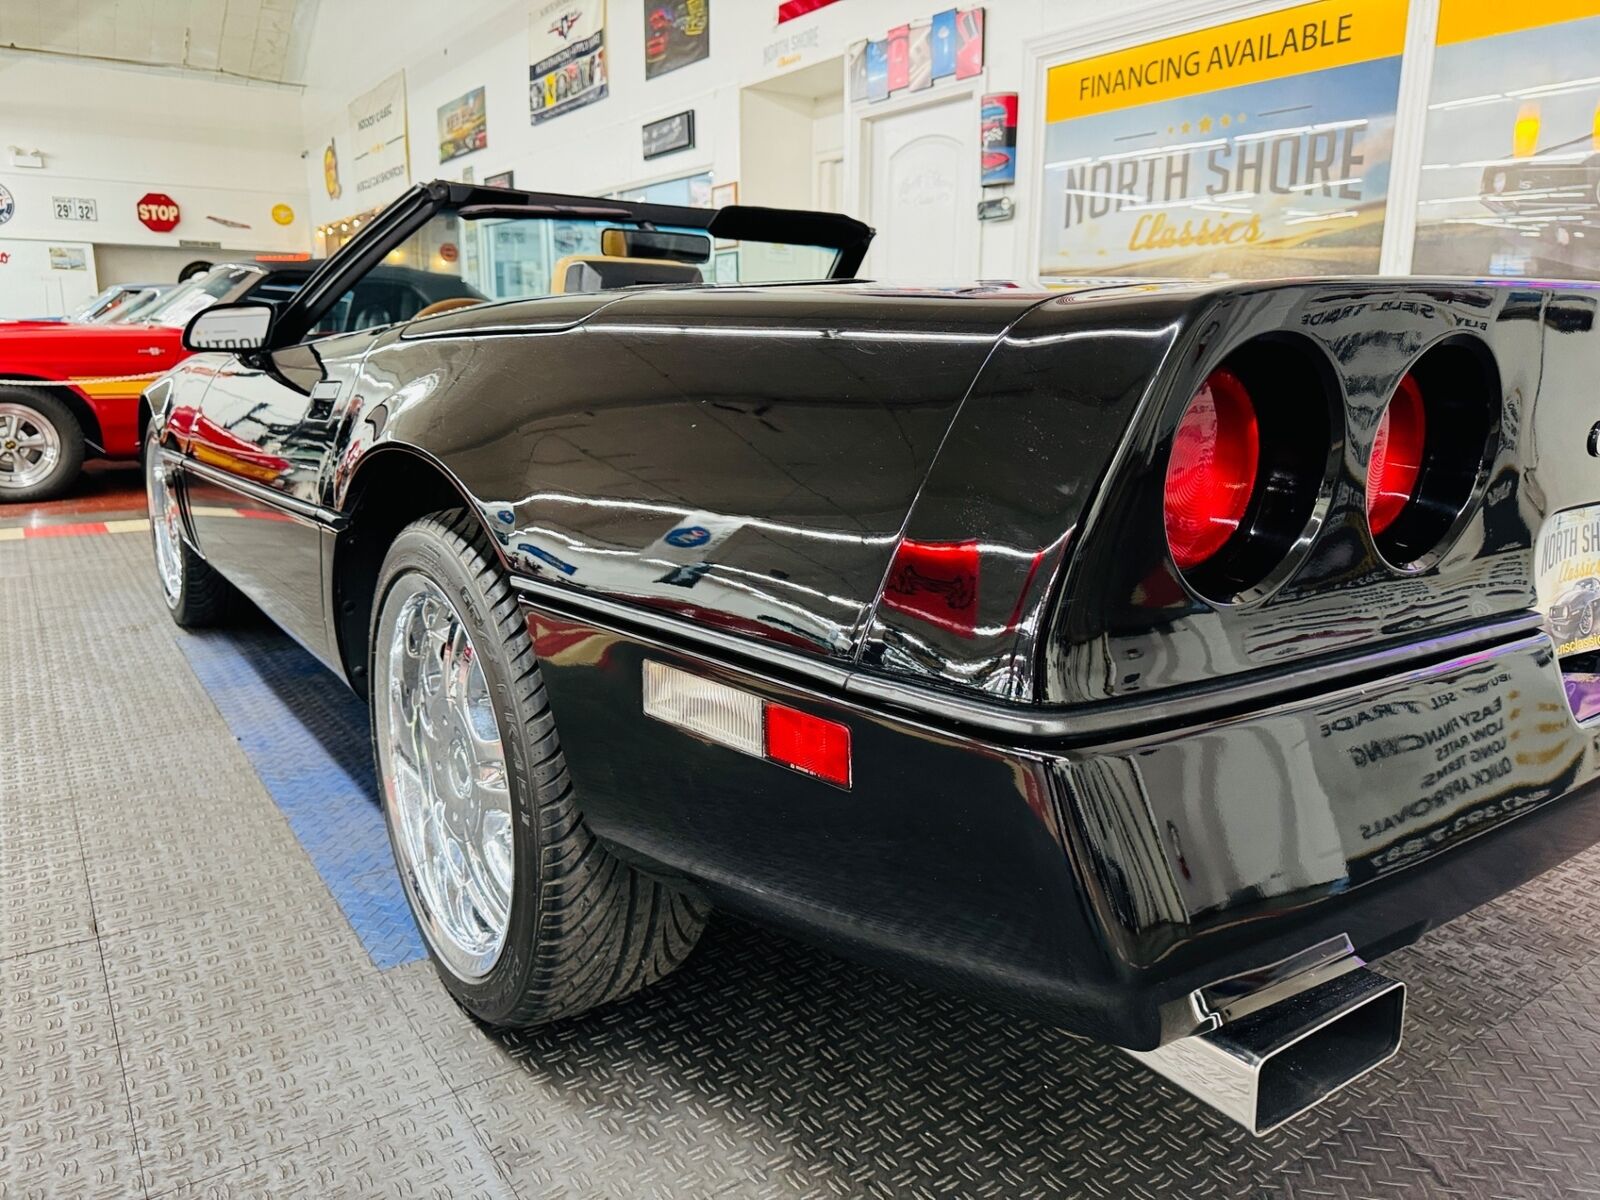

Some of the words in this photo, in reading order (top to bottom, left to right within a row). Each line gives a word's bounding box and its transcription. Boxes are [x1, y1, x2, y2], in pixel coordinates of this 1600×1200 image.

[1078, 50, 1201, 101] FINANCING
[1206, 13, 1354, 74] AVAILABLE
[1064, 151, 1192, 229] NORTH
[1204, 122, 1370, 202] SHORE
[138, 204, 179, 223] STOP
[1127, 212, 1266, 251] Classics
[1540, 526, 1577, 577] NORTH
